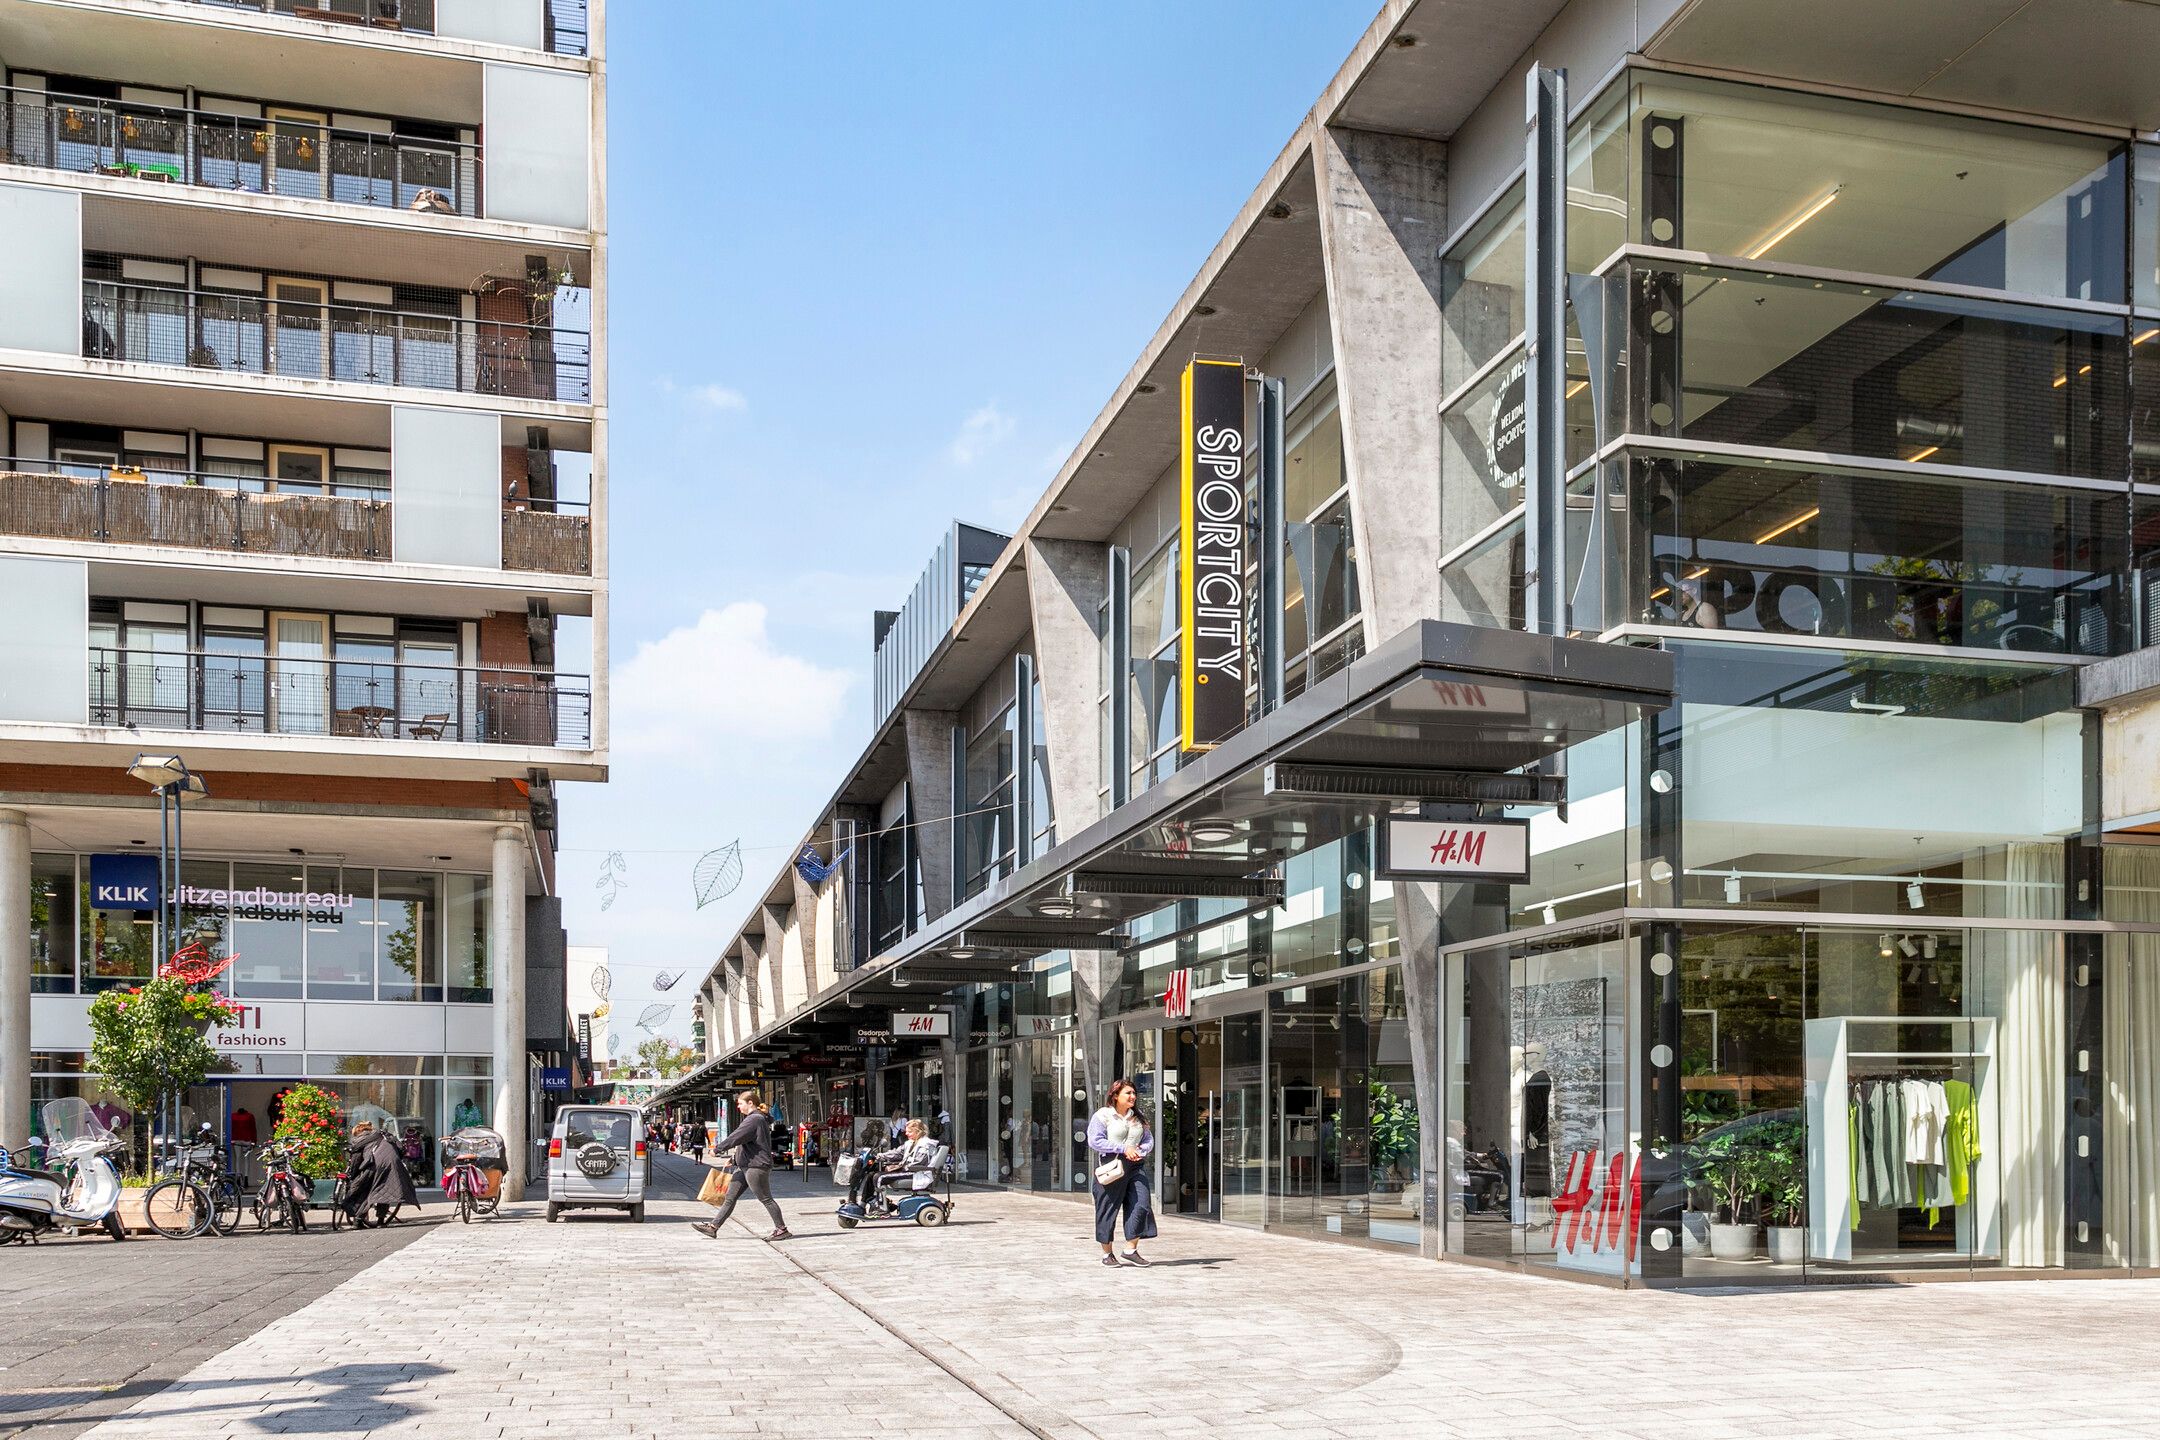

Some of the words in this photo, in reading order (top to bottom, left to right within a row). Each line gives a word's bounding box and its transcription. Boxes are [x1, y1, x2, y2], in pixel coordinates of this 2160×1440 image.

[1497, 420, 1526, 452] SPORTC
[1430, 829, 1487, 866] H&M
[98, 886, 149, 902] KLIK
[164, 884, 353, 908] uitzendbureau
[1163, 968, 1189, 1018] H&M
[908, 1016, 934, 1032] H&M
[217, 1033, 287, 1046] fashions
[579, 1018, 588, 1059] WESTMARKET
[545, 1077, 567, 1086] KLIK
[1551, 1146, 1642, 1263] H&M
